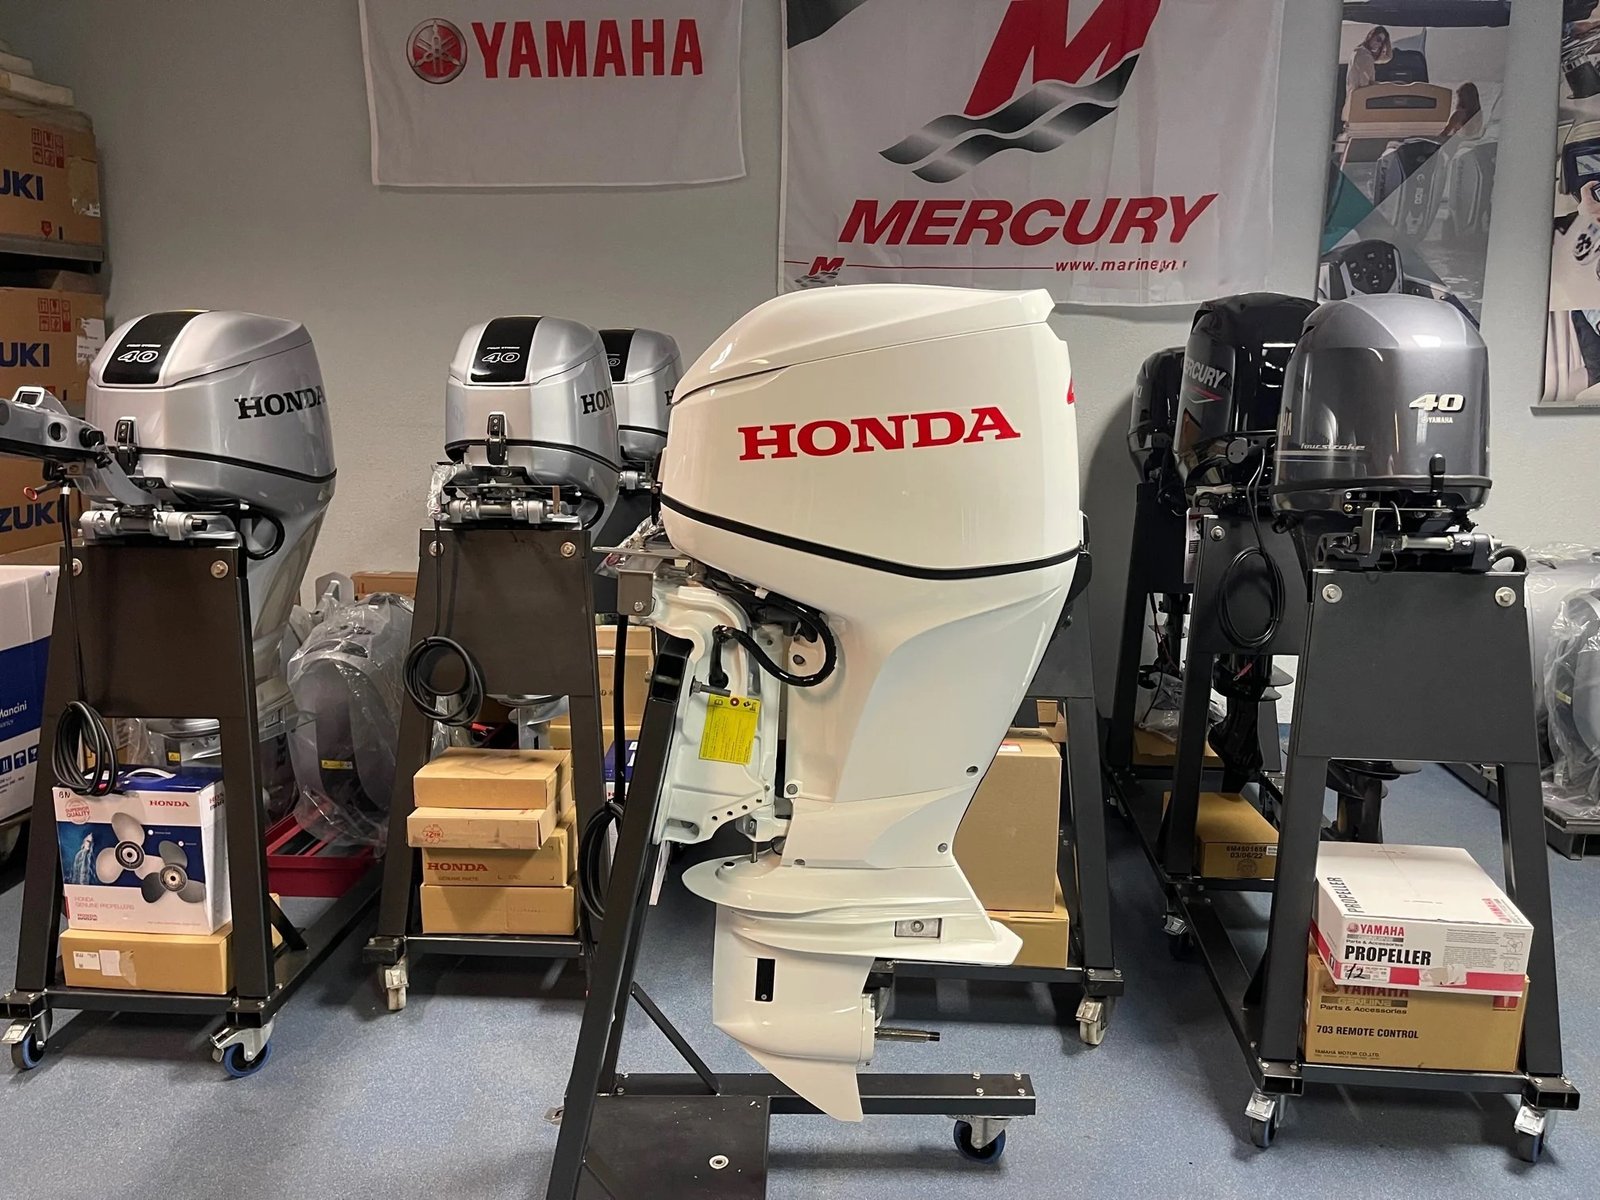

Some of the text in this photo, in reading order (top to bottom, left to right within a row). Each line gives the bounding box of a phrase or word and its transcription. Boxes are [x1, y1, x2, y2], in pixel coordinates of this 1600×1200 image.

[471, 19, 703, 78] YAMAHA
[838, 193, 1218, 245] MERCURY
[117, 350, 159, 363] 40
[481, 352, 520, 363] 40
[234, 385, 325, 419] HONDA
[1408, 394, 1464, 411] 40
[1428, 416, 1453, 424] YAMAHA
[738, 406, 1021, 461] HONDA
[427, 862, 489, 871] HONDA
[1327, 876, 1365, 913] PROPELLER
[1360, 924, 1404, 936] YAMAHA
[1344, 945, 1431, 966] PROPELLER
[1347, 963, 1366, 980] 12
[1354, 1006, 1407, 1015] Accessories
[1316, 1025, 1419, 1039] 703 REMOTE CONTROL
